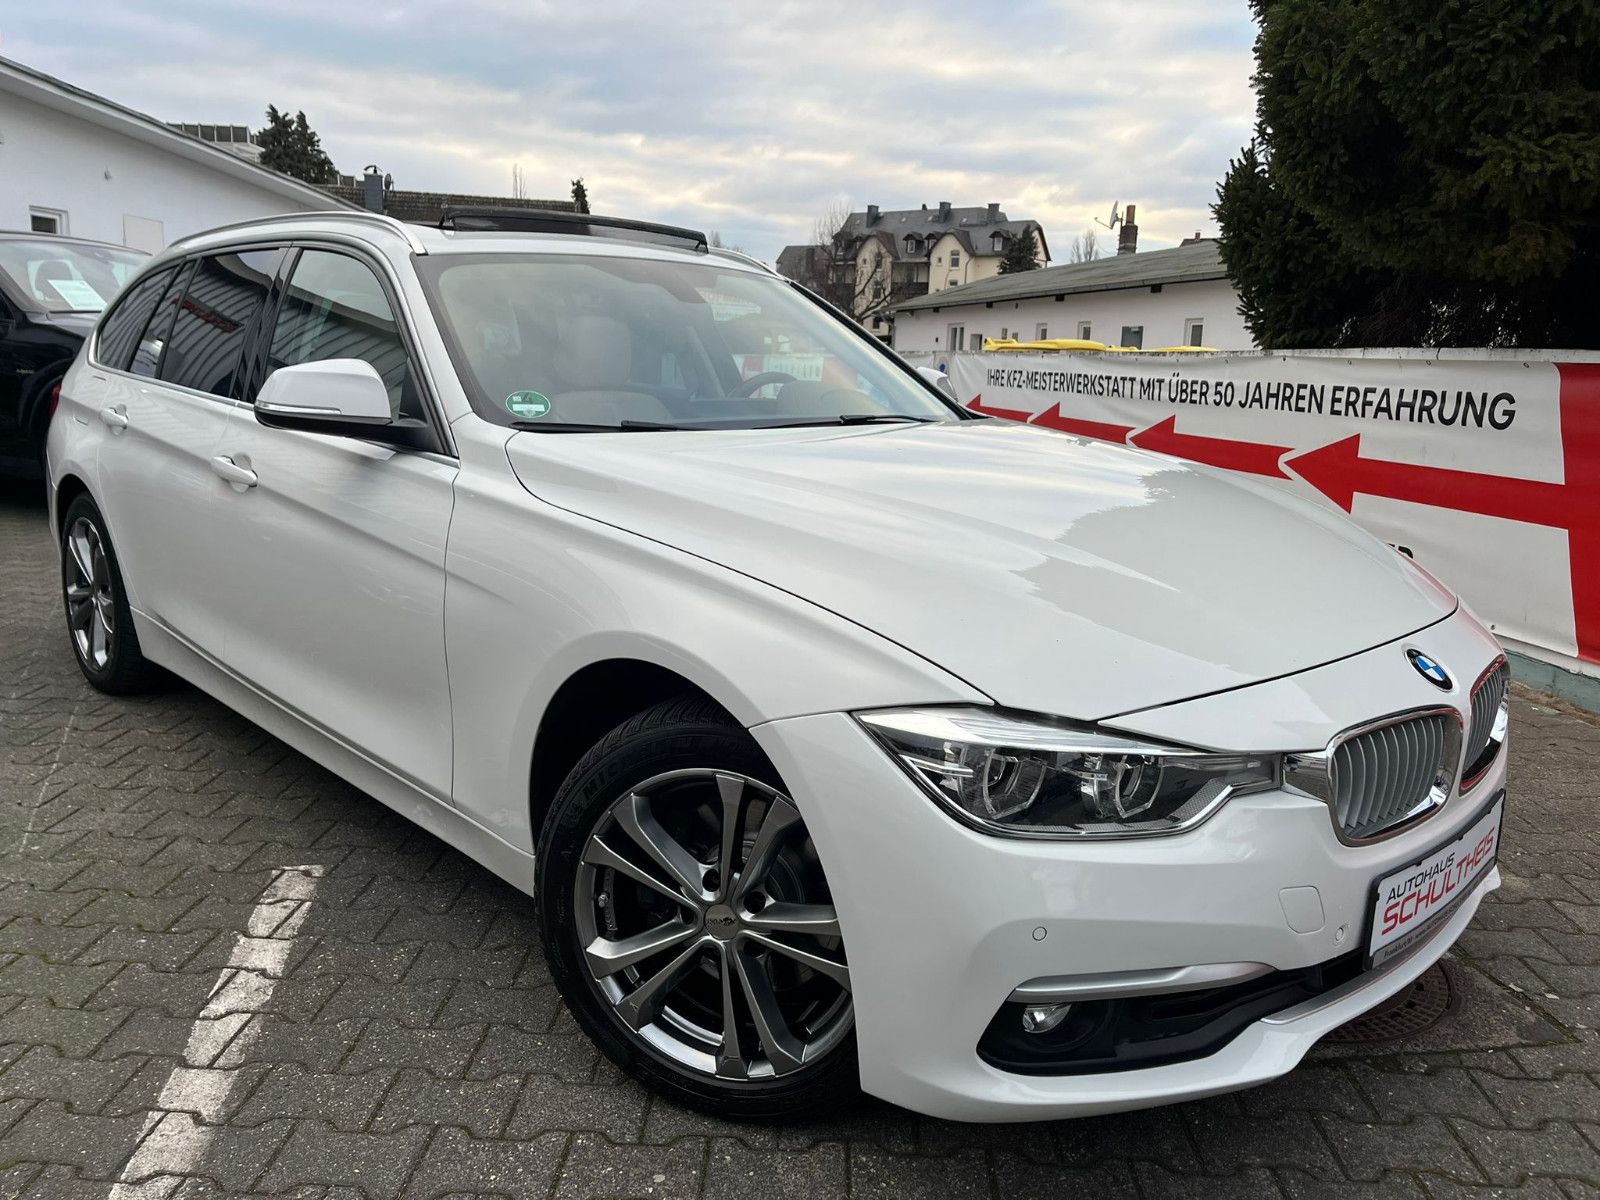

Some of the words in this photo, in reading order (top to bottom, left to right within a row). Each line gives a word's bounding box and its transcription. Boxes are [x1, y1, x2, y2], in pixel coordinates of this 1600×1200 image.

[987, 368, 1005, 387] IHRE
[1006, 370, 1137, 399] KFZ-MEISTERWERKSTATT
[1139, 377, 1165, 401] MIT
[1168, 372, 1209, 406] ÜBER
[1213, 381, 1235, 408] 50
[1238, 381, 1325, 415] JAHREN
[1330, 385, 1516, 431] ERFAHRUNG
[1381, 826, 1495, 936] SCHULTHEIS
[1386, 852, 1456, 905] AUTOHAUS
